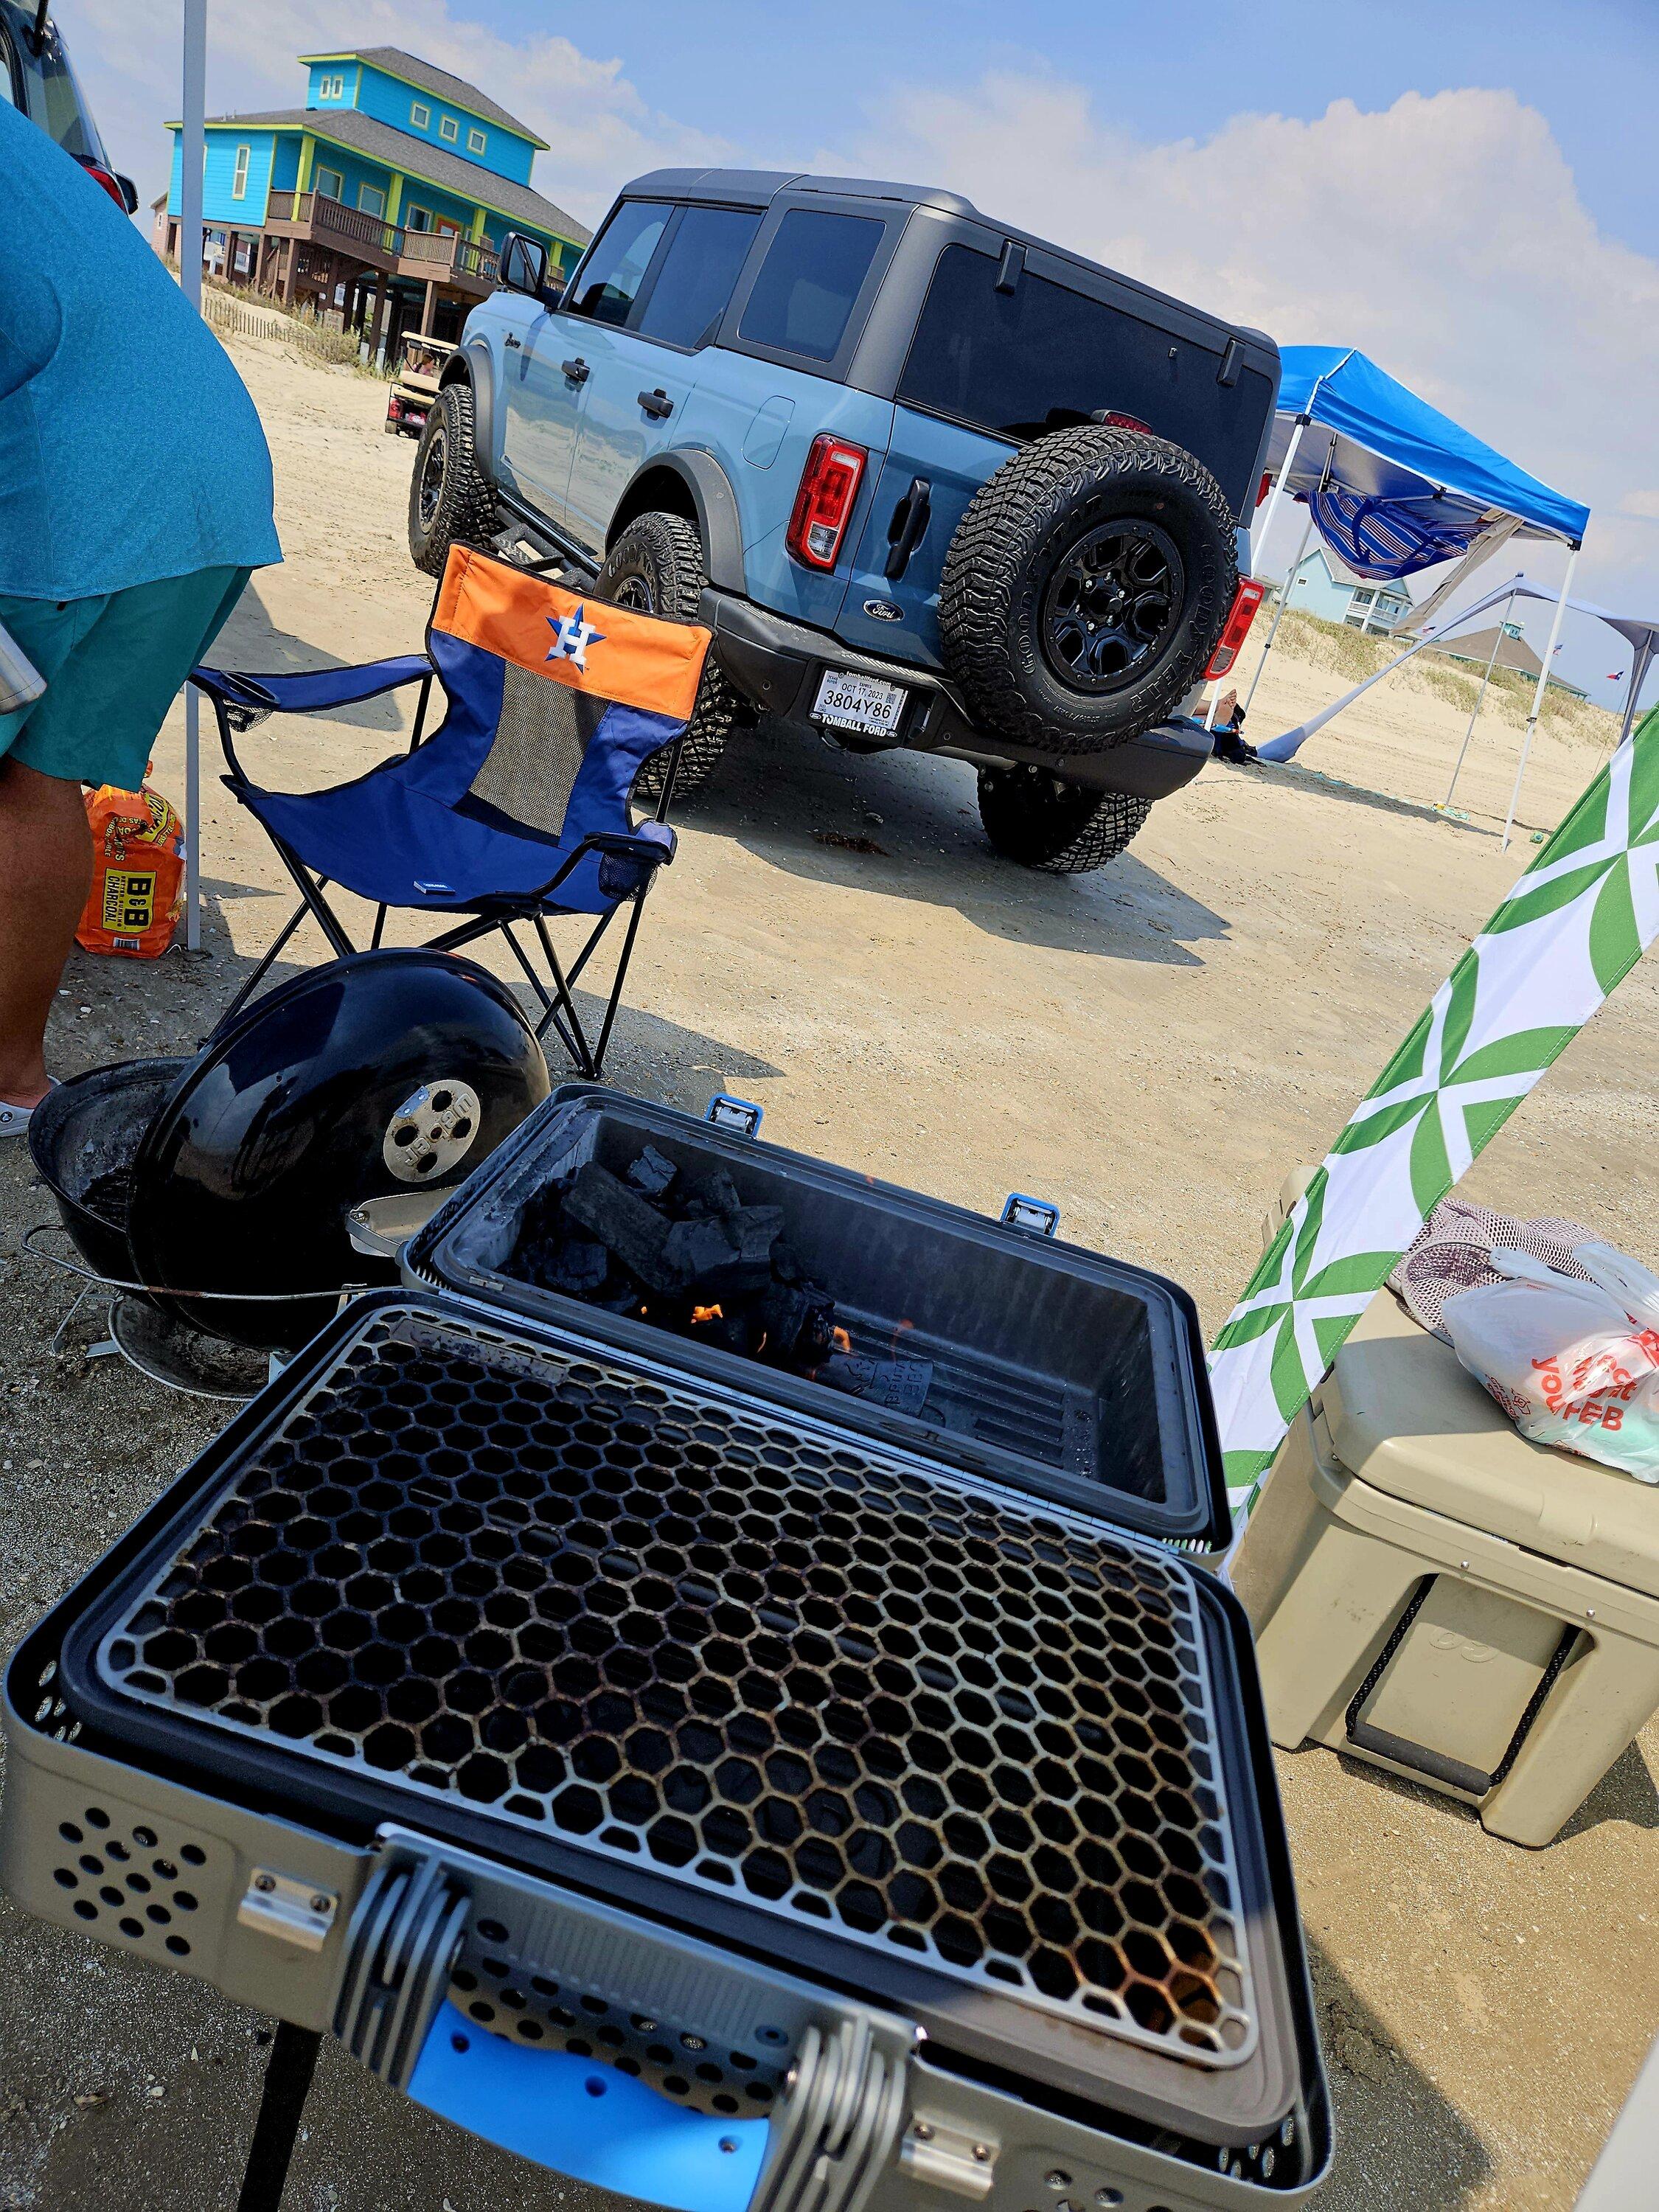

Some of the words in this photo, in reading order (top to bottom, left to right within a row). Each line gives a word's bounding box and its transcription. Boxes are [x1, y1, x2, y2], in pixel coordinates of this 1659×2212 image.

[549, 615, 597, 665] H
[1130, 543, 1217, 712] GOODYEAR
[841, 683, 858, 694] OCT
[858, 686, 867, 698] 17,
[869, 690, 883, 700] 2023
[846, 671, 891, 686] tomballford.com
[821, 713, 862, 732] TOMBALL
[862, 723, 888, 737] FORD
[824, 689, 892, 720] 3804Y86
[105, 875, 120, 922] CHARCOAL
[124, 877, 153, 927] B&B
[404, 1092, 475, 1167] weber
